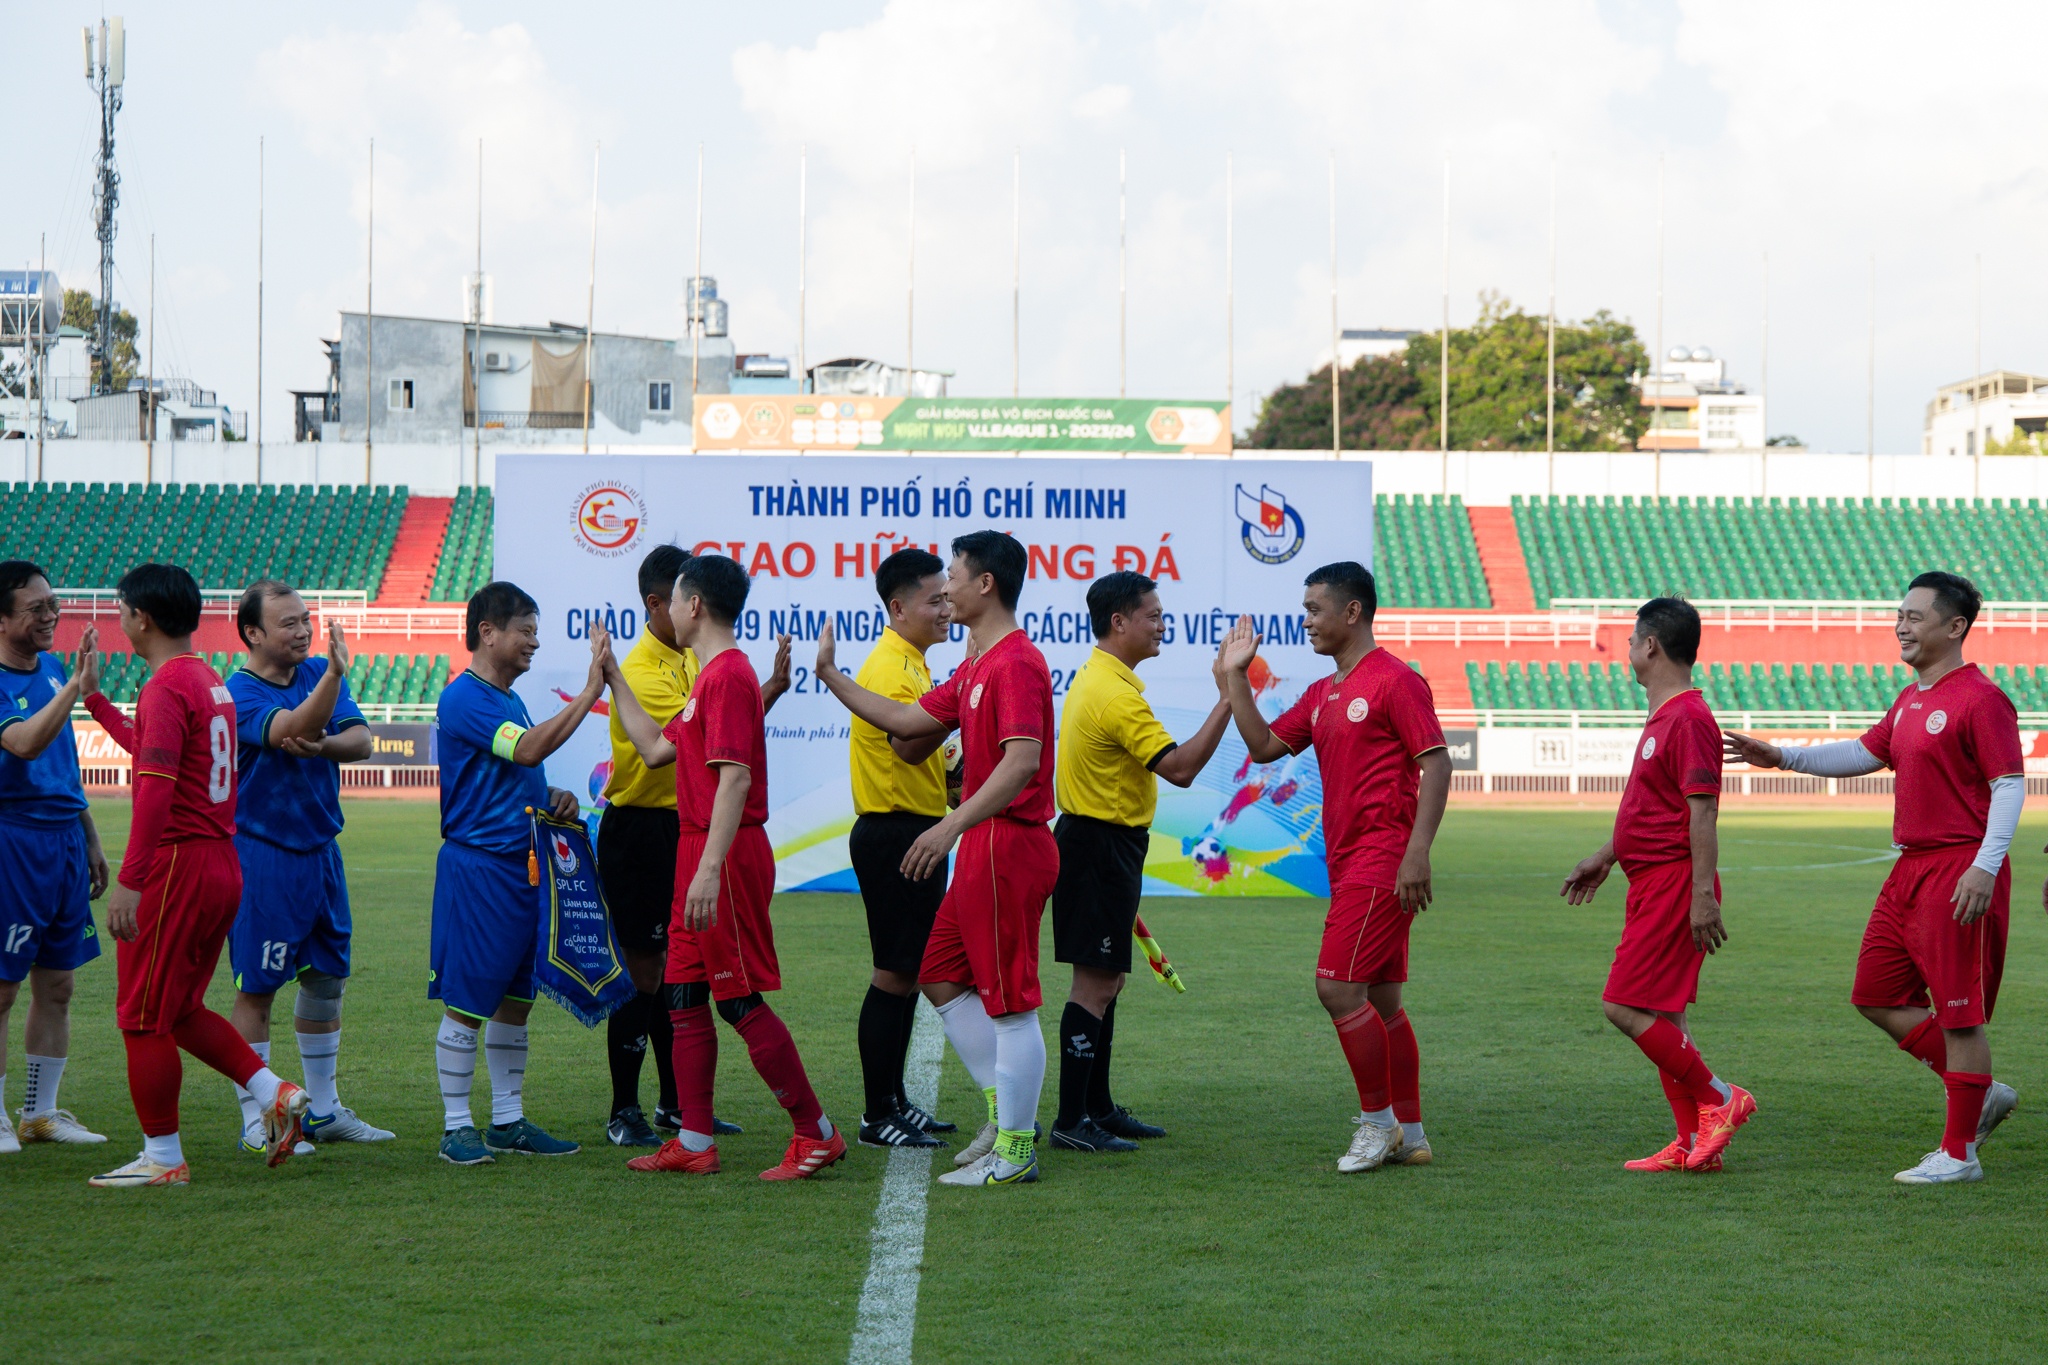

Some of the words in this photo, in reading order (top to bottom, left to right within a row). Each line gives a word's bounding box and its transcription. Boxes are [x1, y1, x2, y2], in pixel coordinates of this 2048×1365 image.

[1092, 409, 1114, 421] GIA
[893, 422, 930, 439] NIGHT
[932, 423, 966, 439] WOLF
[968, 424, 1048, 439] V.LEAGUE
[1049, 424, 1059, 438] 1
[1069, 425, 1136, 439] 2023/24
[748, 479, 849, 517] THÀNH
[860, 476, 921, 518] PHỐ
[933, 475, 972, 518] HỒ
[984, 478, 1033, 519] CHÍ
[1044, 488, 1127, 520] MINH
[1112, 532, 1181, 581] ĐÁ
[567, 602, 636, 640] CHÀO
[769, 603, 826, 641] NĂM
[836, 603, 886, 642] NGÀ
[1023, 606, 1091, 644] CÁCH
[1251, 614, 1306, 645] NAM
[501, 725, 519, 741] C
[764, 725, 806, 739] Thành
[808, 723, 836, 742] phố
[839, 727, 851, 739] H
[208, 714, 238, 804] 8
[556, 877, 573, 891] SPL
[573, 879, 588, 892] FC
[572, 908, 589, 919] PHÍA
[582, 900, 598, 911] ĐẠO
[564, 936, 574, 948] CÔ
[572, 932, 587, 943] CÁN
[588, 933, 599, 945] BỘ
[261, 939, 289, 972] 13
[1066, 1047, 1095, 1059] egan
